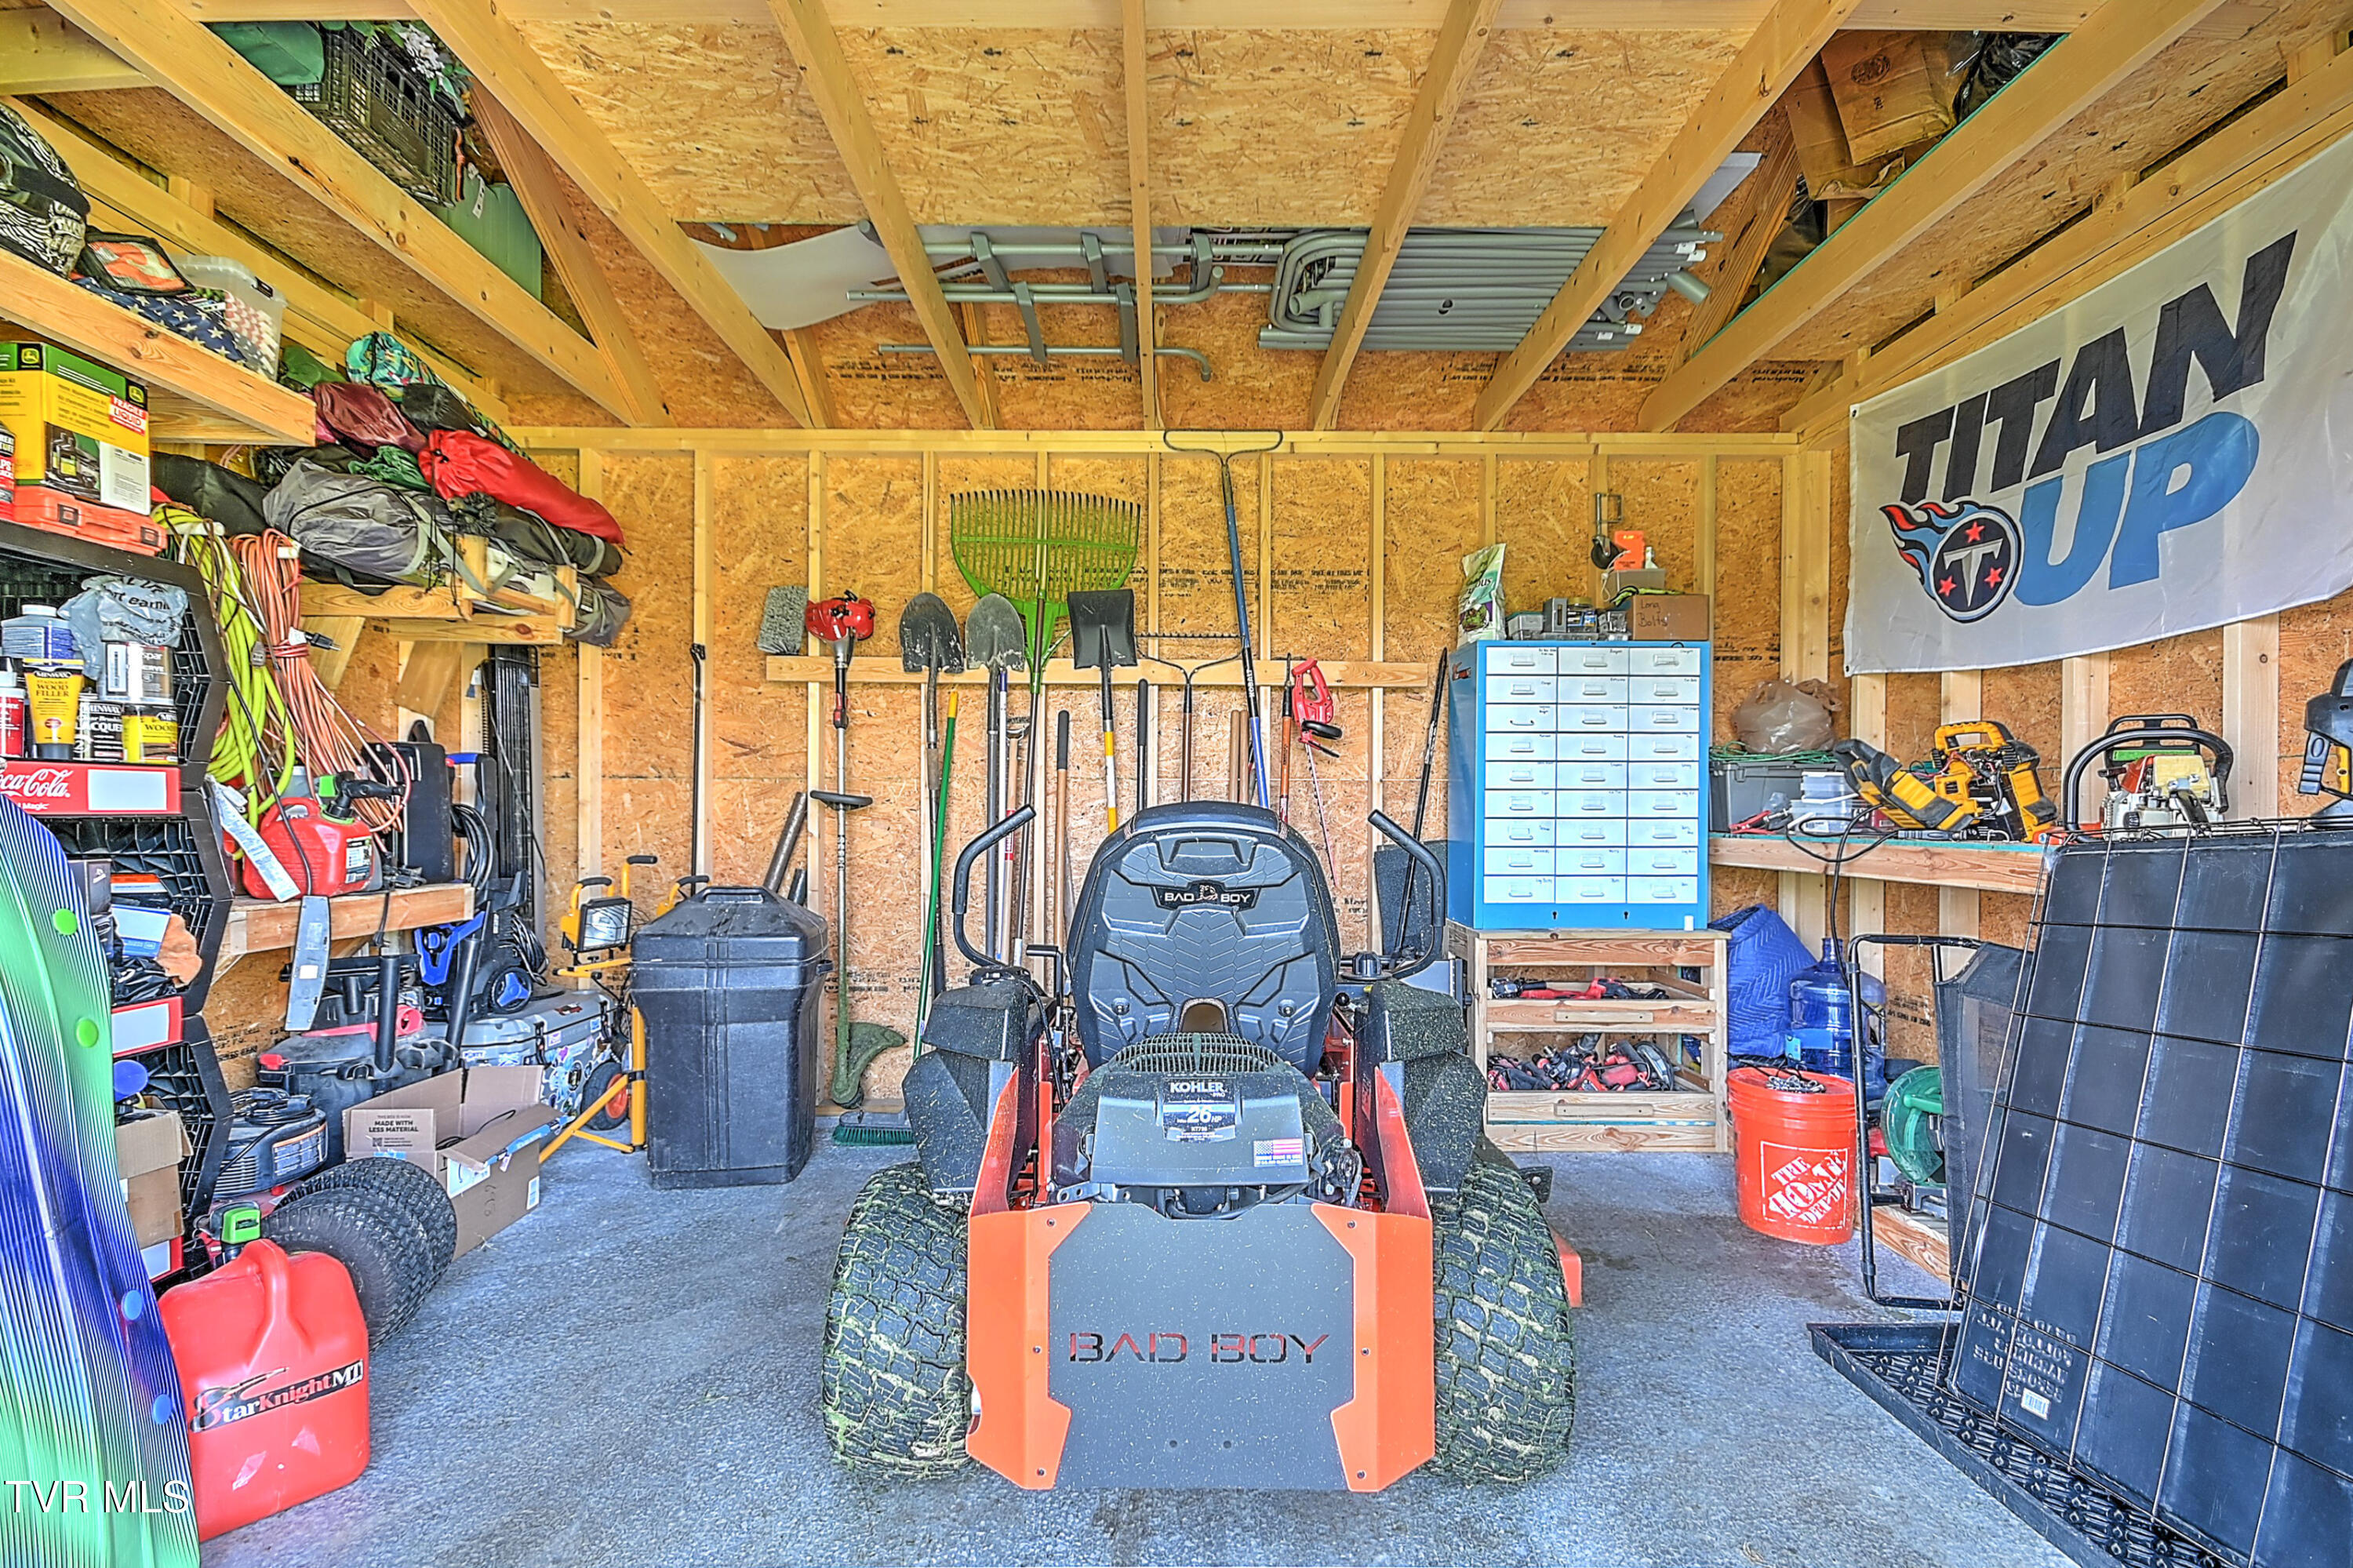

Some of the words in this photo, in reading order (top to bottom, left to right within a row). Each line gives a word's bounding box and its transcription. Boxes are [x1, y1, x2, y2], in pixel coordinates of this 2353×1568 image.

[1896, 229, 2297, 503] TITAN
[113, 396, 144, 418] FRAGILE
[114, 407, 142, 427] LIQUID
[2013, 412, 2260, 606] UP
[1641, 599, 1660, 613] Long
[1636, 613, 1667, 627] Bolts
[1164, 893, 1195, 901] BAD
[1220, 893, 1251, 903] BOY
[1169, 1082, 1224, 1093] KOHLER
[1187, 1106, 1212, 1123] 26
[1771, 1156, 1811, 1185] THE
[1769, 1155, 1846, 1220] HOME
[1798, 1178, 1846, 1224] DEPOT
[1069, 1332, 1187, 1363] BAD
[1210, 1333, 1330, 1364] BOY
